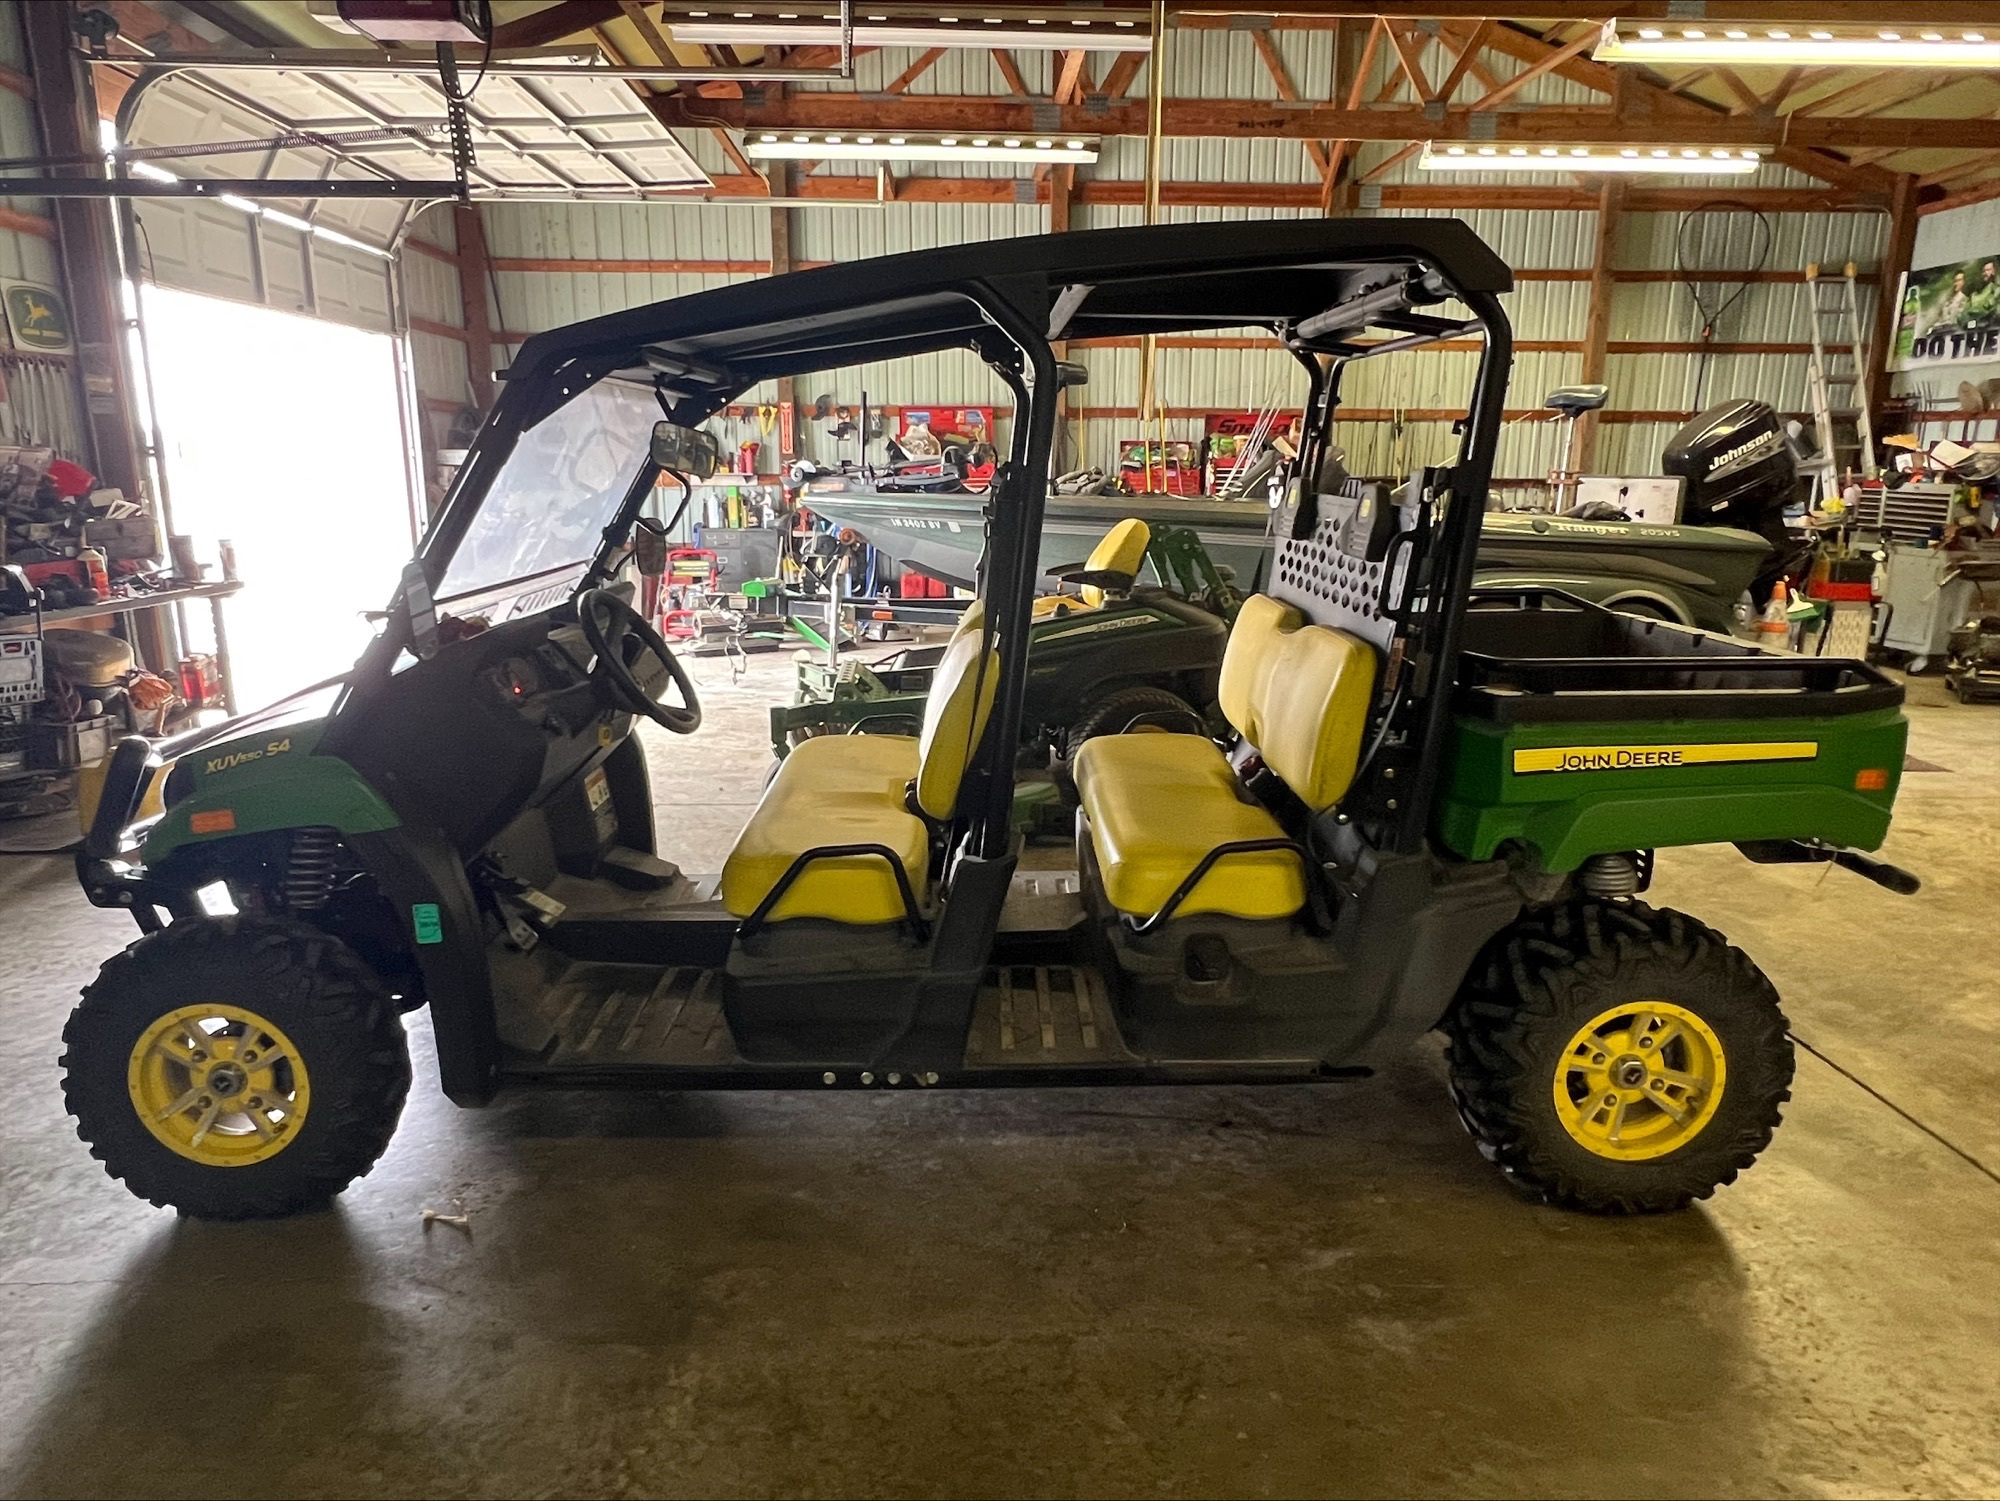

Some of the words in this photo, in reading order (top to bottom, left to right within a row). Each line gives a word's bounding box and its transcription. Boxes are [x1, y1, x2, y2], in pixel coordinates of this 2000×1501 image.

[1950, 329, 1999, 359] THE
[1708, 430, 1773, 471] Johnson
[266, 738, 291, 757] S4
[1555, 753, 1611, 769] JOHN
[1616, 750, 1683, 766] DEERE
